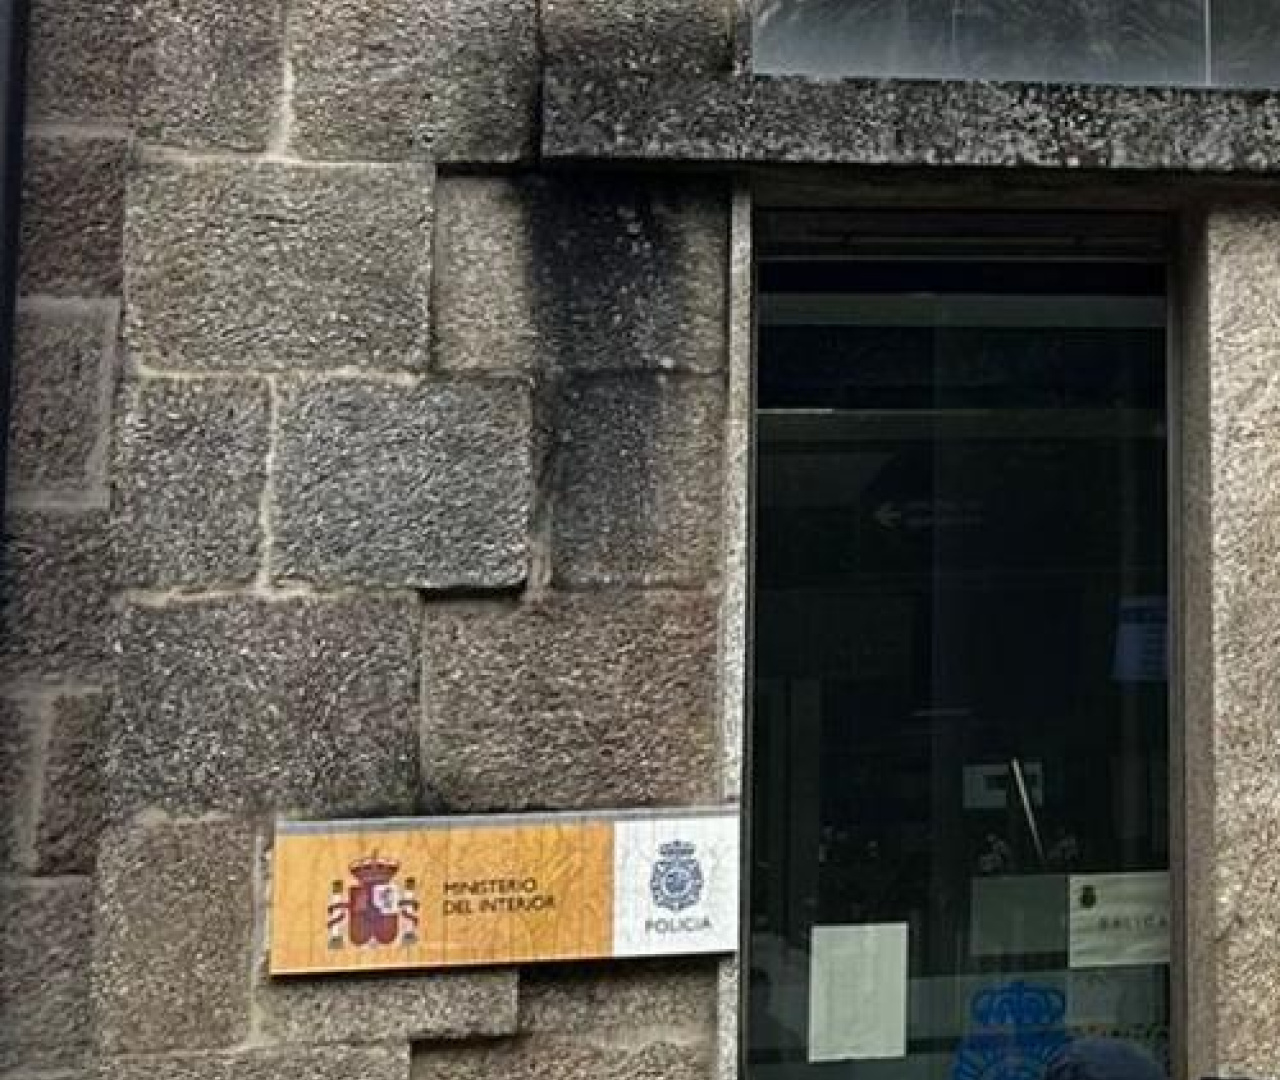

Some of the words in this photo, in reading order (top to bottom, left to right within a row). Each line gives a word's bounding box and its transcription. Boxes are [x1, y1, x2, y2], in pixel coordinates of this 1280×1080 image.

[443, 877, 537, 895] MINISTERIO
[443, 899, 473, 915] DEL
[478, 895, 555, 913] INTERIOR
